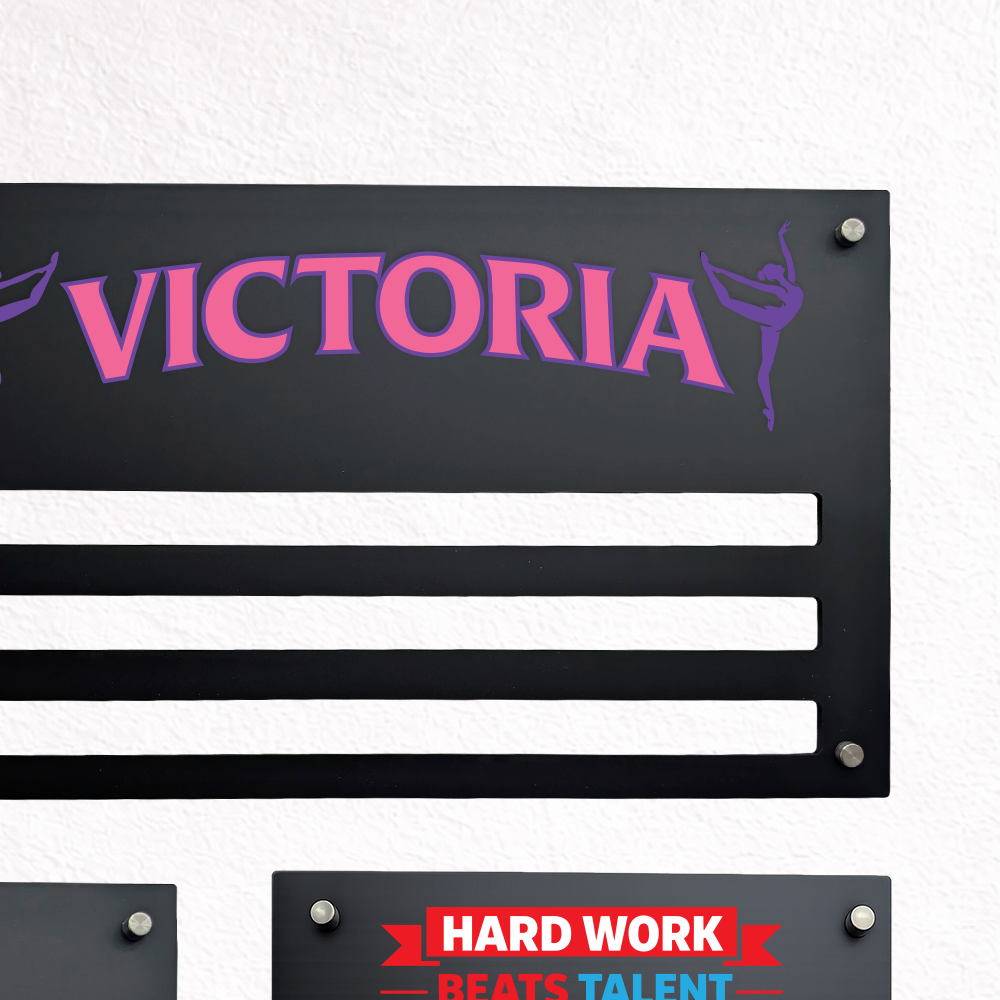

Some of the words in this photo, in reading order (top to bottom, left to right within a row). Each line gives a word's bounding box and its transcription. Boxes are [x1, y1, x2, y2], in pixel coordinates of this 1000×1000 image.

[61, 251, 734, 393] VICTORIA
[444, 916, 571, 951] HARD
[583, 916, 723, 951] WORK
